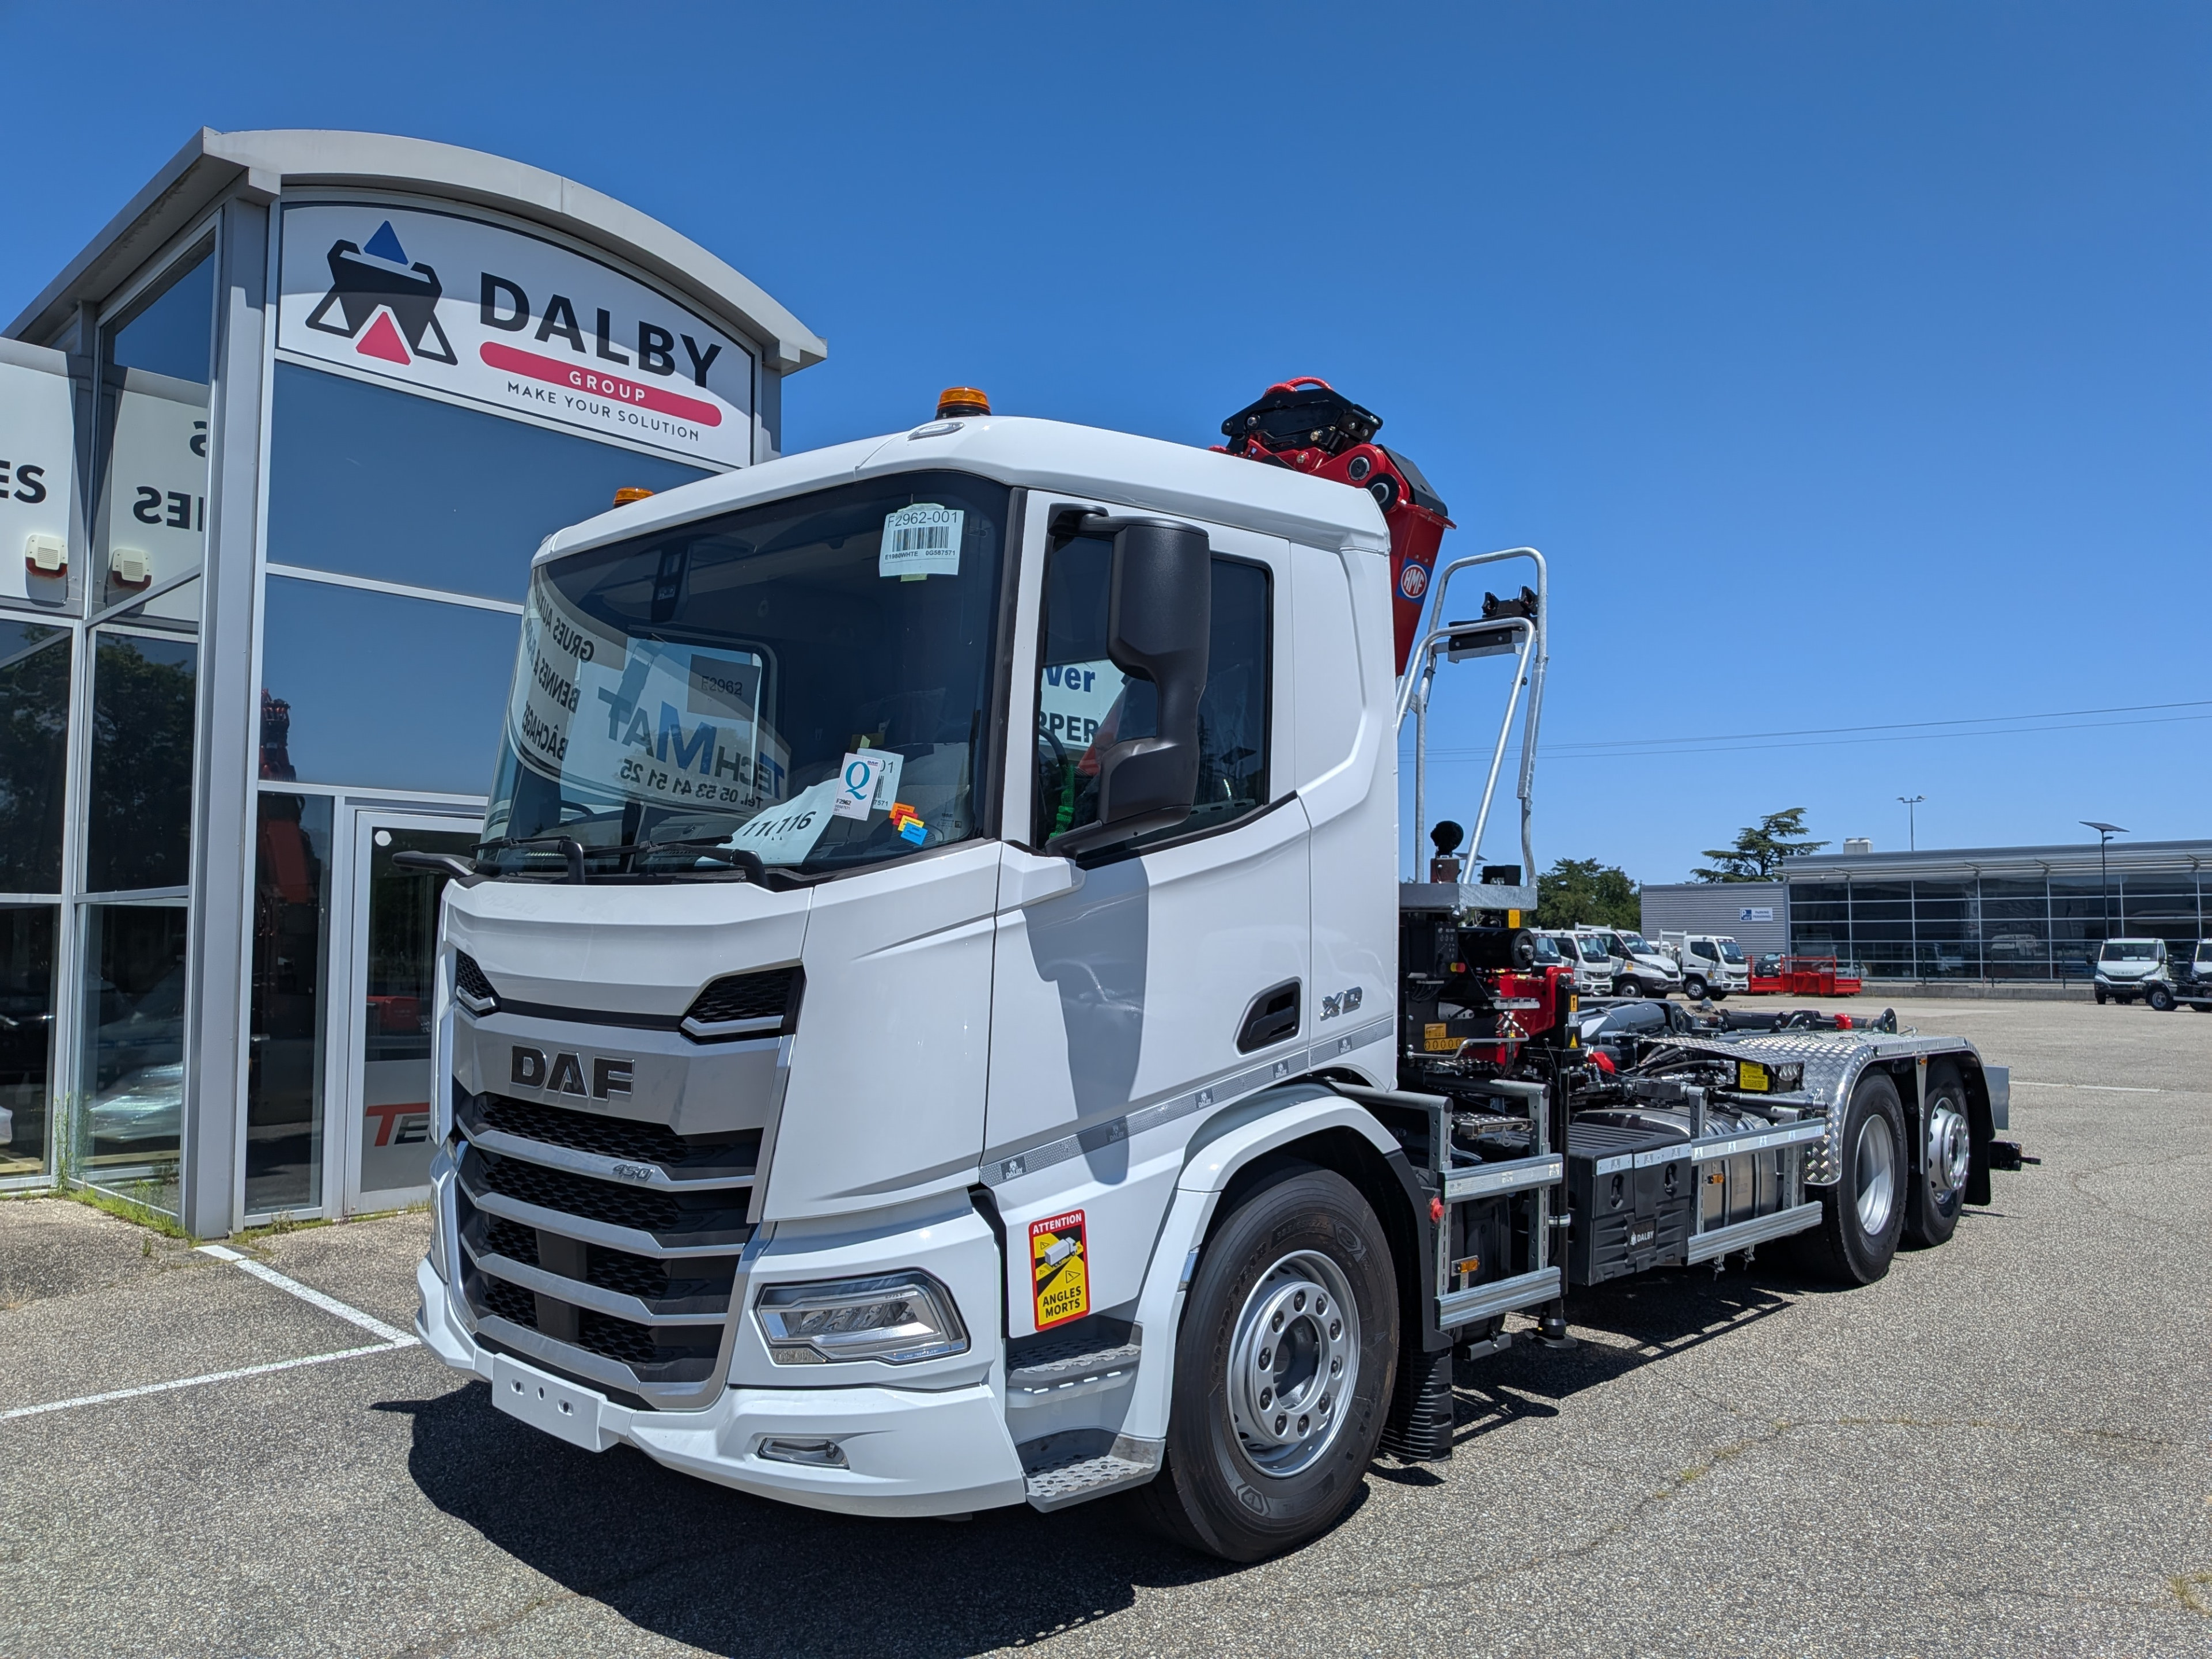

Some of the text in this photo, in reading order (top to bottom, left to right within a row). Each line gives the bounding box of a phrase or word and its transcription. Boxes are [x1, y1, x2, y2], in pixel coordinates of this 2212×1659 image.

[480, 272, 722, 388] DALBY
[569, 370, 646, 403] GROUP
[508, 381, 699, 442] MAKE YOUR SOLUTION
[888, 511, 957, 528] F2962-001
[885, 551, 918, 560] E1980WHTE
[1403, 568, 1425, 594] HMF
[845, 761, 870, 800] Q
[1320, 986, 1362, 1021] XD
[510, 1043, 635, 1103] DAF
[365, 1102, 431, 1147] TE
[1109, 1131, 1124, 1142] DALBY
[613, 1164, 654, 1181] 450
[1006, 1167, 1023, 1179] DALBY
[1033, 1213, 1082, 1234] ATTENTION
[1637, 1230, 1654, 1242] DALBY
[1043, 1286, 1081, 1306] ANGLES
[1046, 1298, 1081, 1318] MORTS
